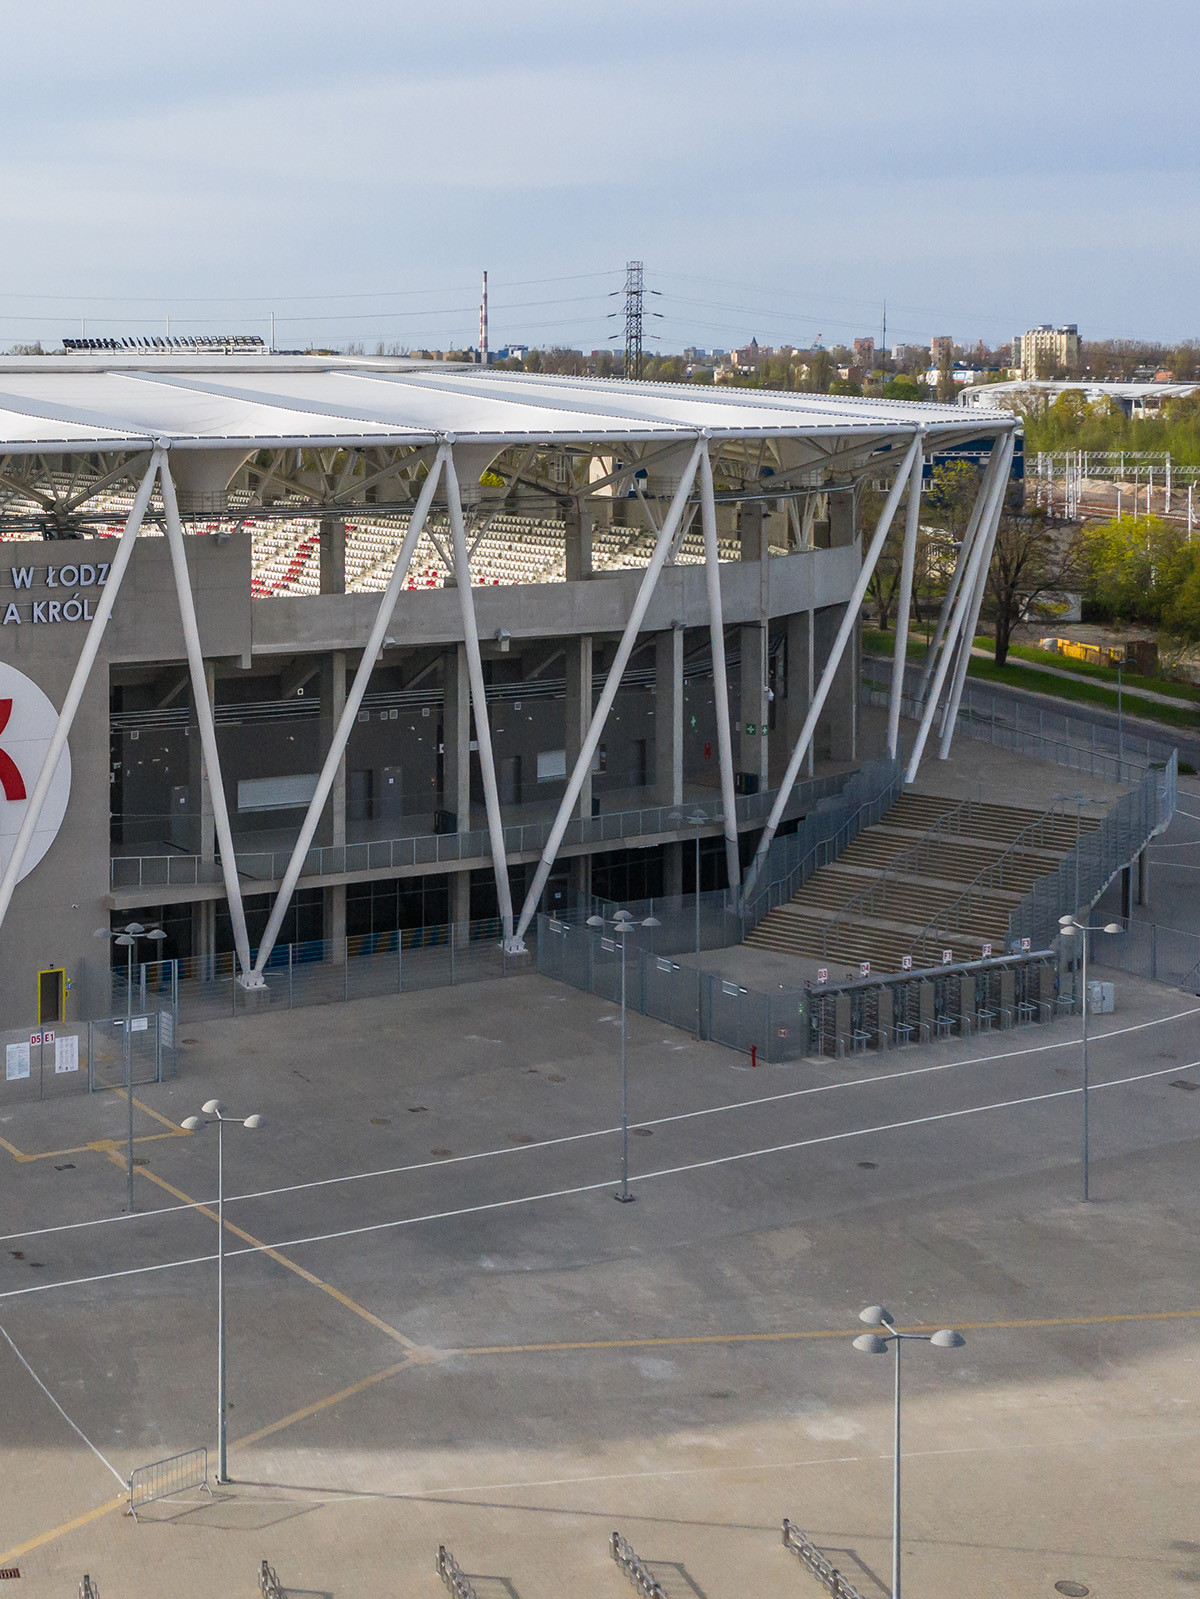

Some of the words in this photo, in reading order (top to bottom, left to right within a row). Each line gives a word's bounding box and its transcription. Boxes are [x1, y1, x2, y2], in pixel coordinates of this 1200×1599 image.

[11, 566, 35, 589] W
[45, 563, 114, 588] ŁODZ
[32, 592, 113, 623] KRÓL
[31, 1035, 41, 1044] D5
[45, 1034, 54, 1042] E1
